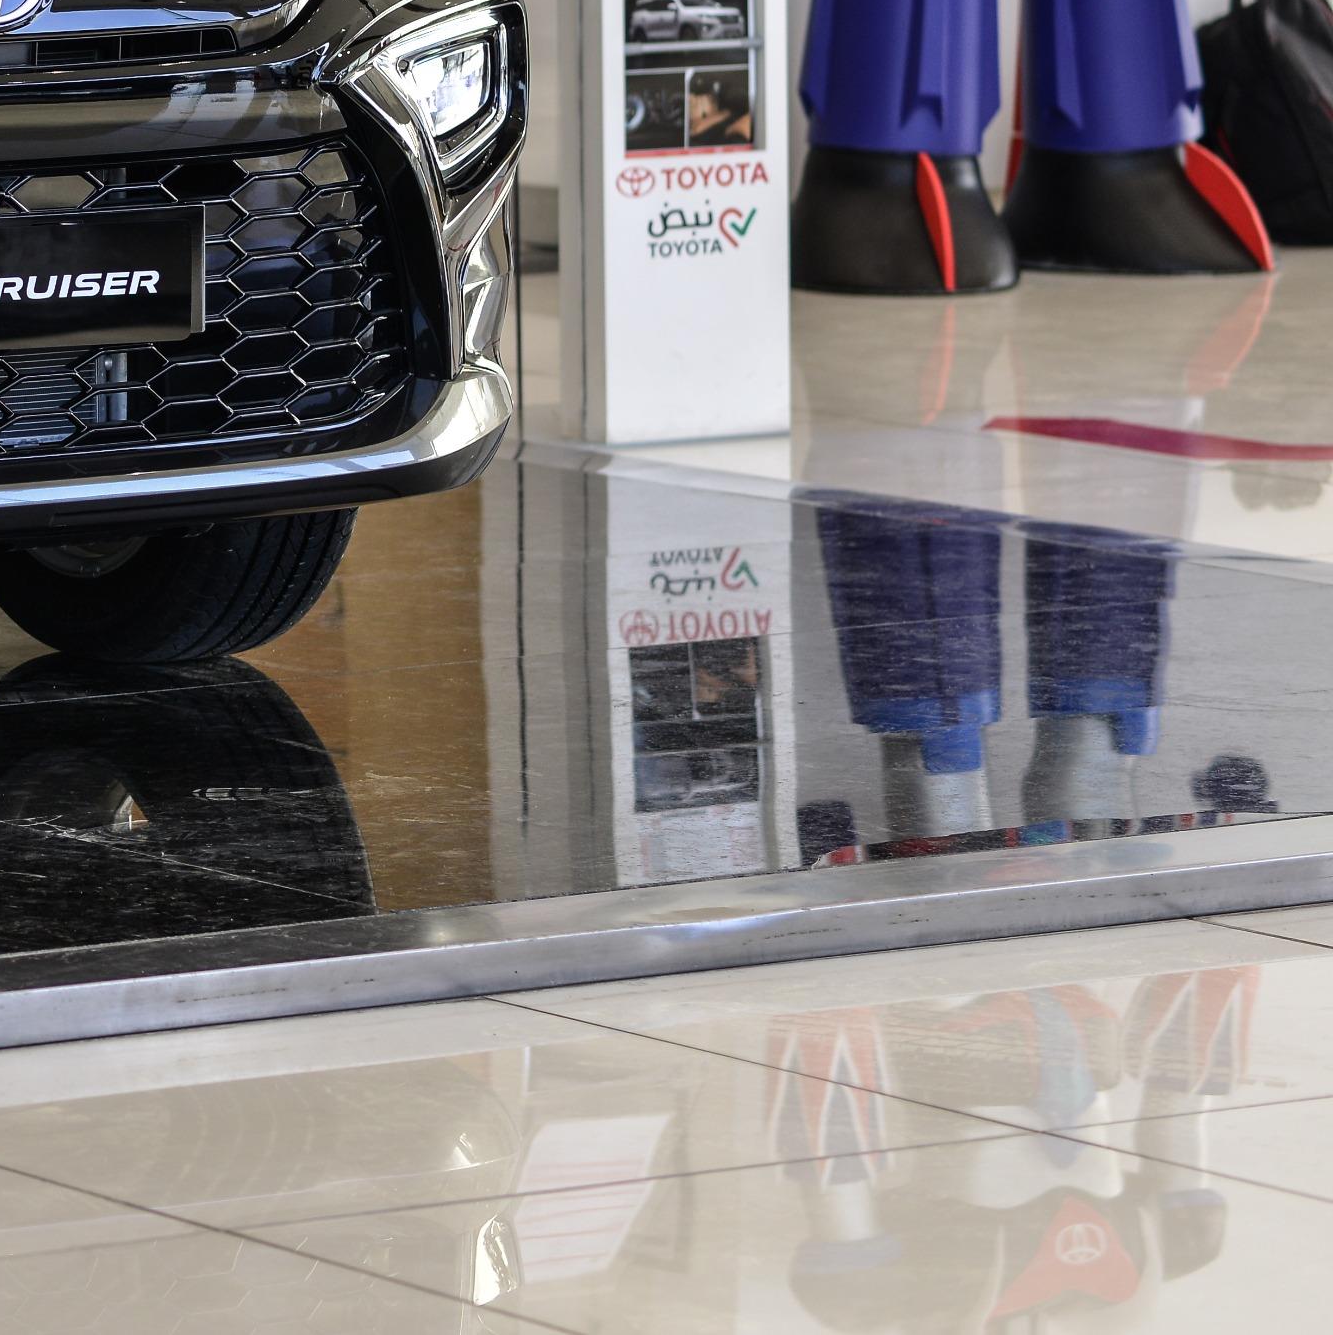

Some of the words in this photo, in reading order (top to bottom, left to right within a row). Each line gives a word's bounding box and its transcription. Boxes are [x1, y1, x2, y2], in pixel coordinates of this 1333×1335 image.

[661, 162, 769, 190] TOYOTA
[648, 198, 713, 238] نبض
[648, 239, 723, 258] TOYOTA
